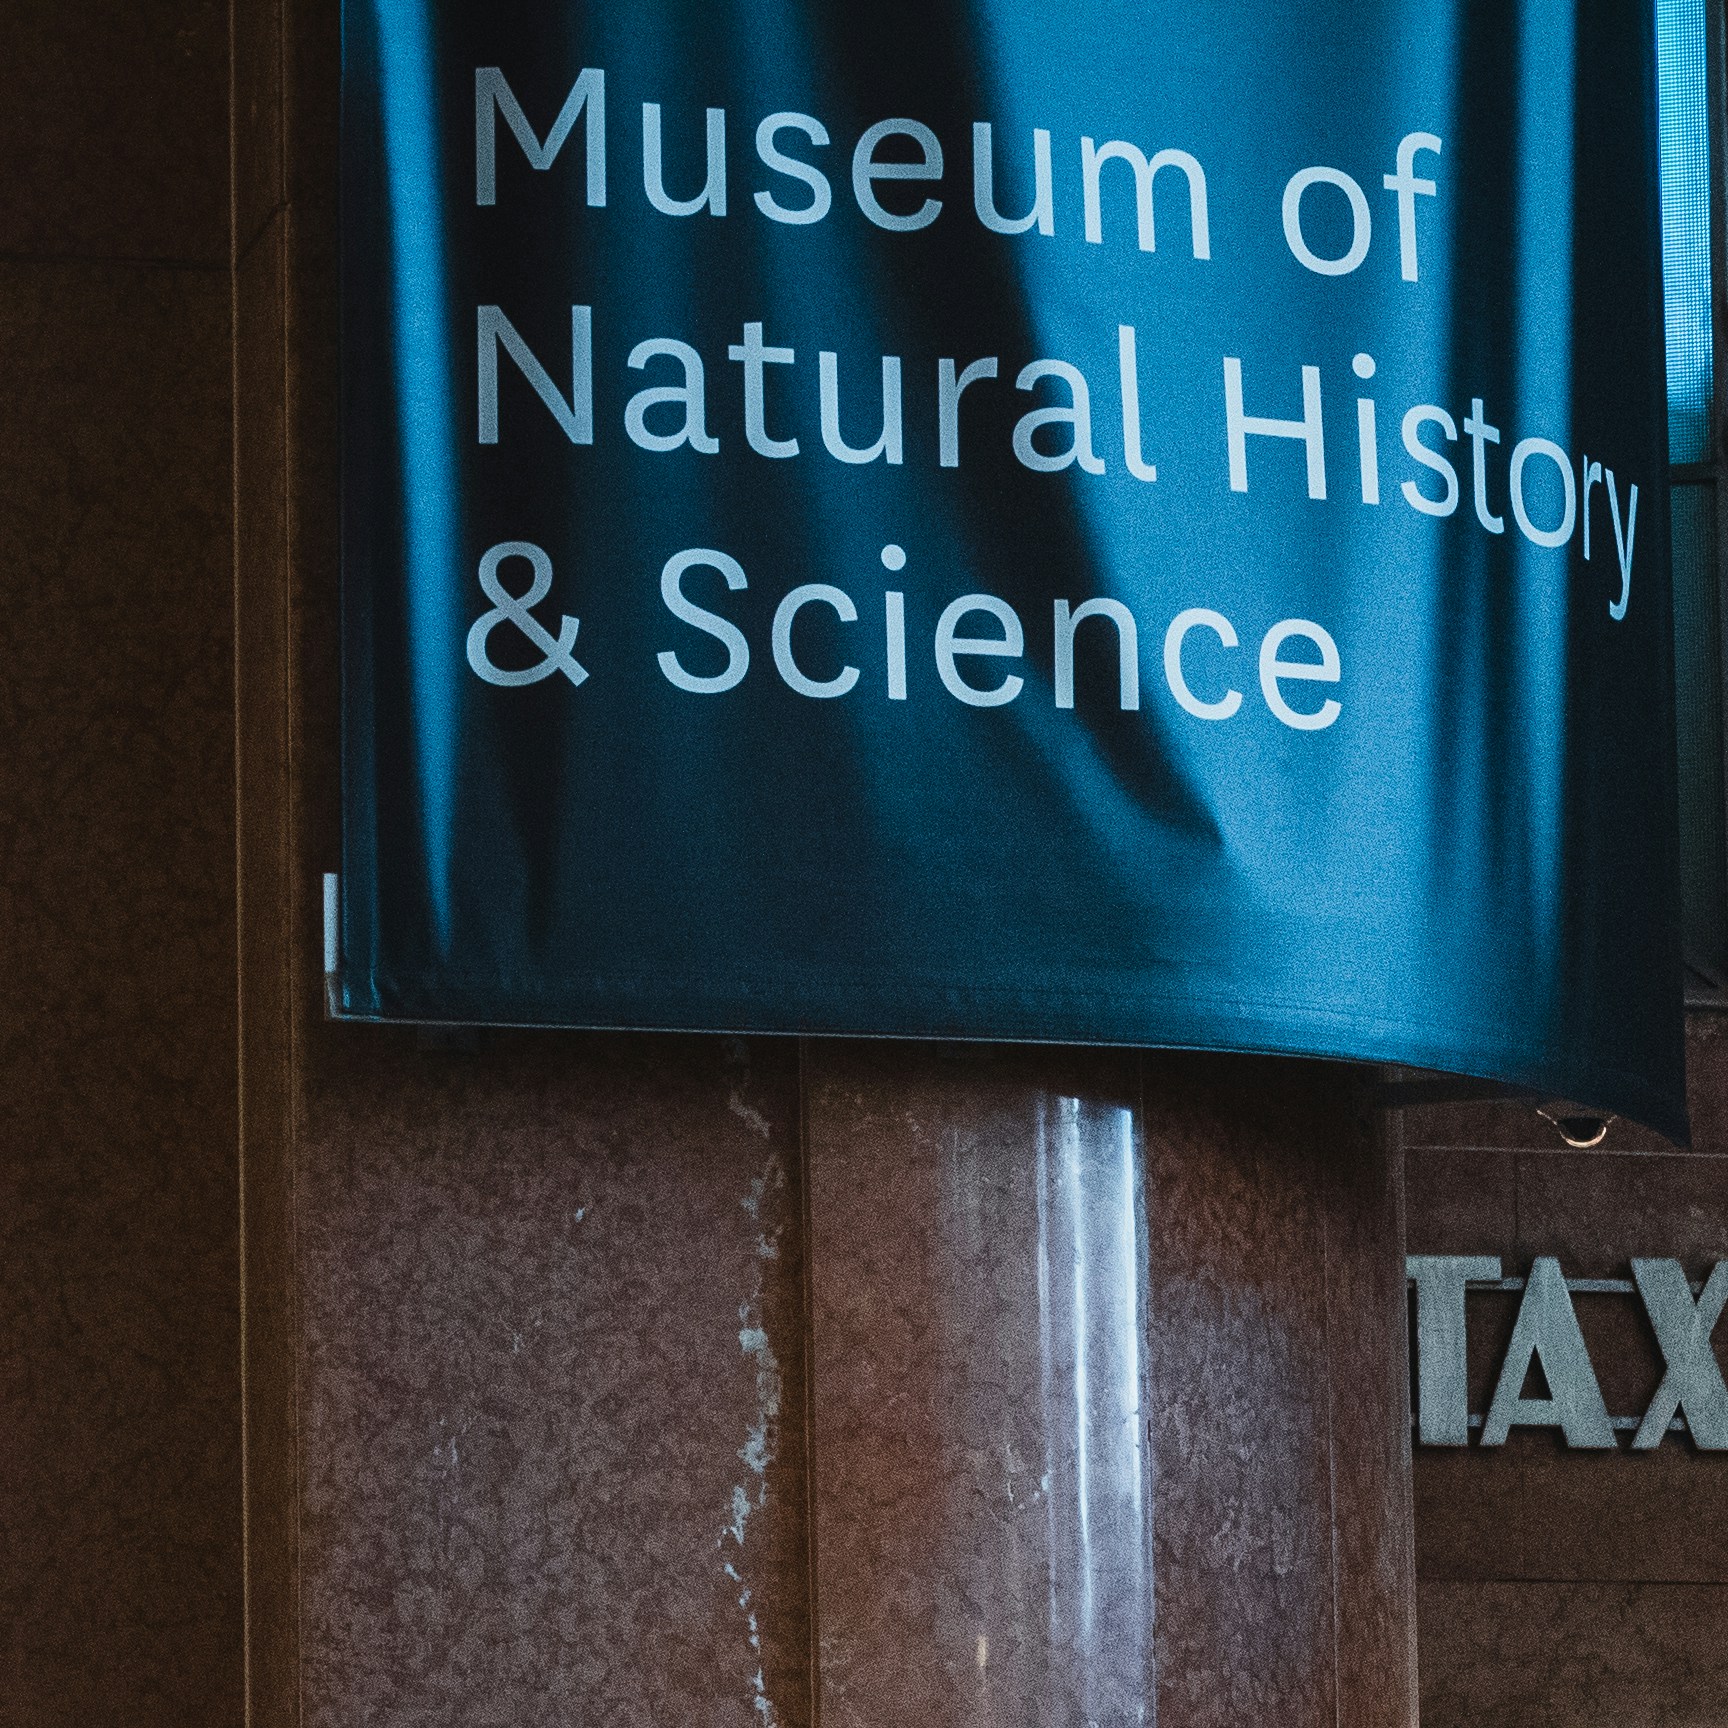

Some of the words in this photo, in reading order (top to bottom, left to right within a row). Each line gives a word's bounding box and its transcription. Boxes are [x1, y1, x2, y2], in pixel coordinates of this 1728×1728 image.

[475, 67, 1212, 261] Museum
[1281, 131, 1441, 282] of
[477, 304, 1157, 483] Natural
[1222, 352, 1638, 621] History
[466, 540, 590, 689] &
[656, 545, 1343, 731] Science
